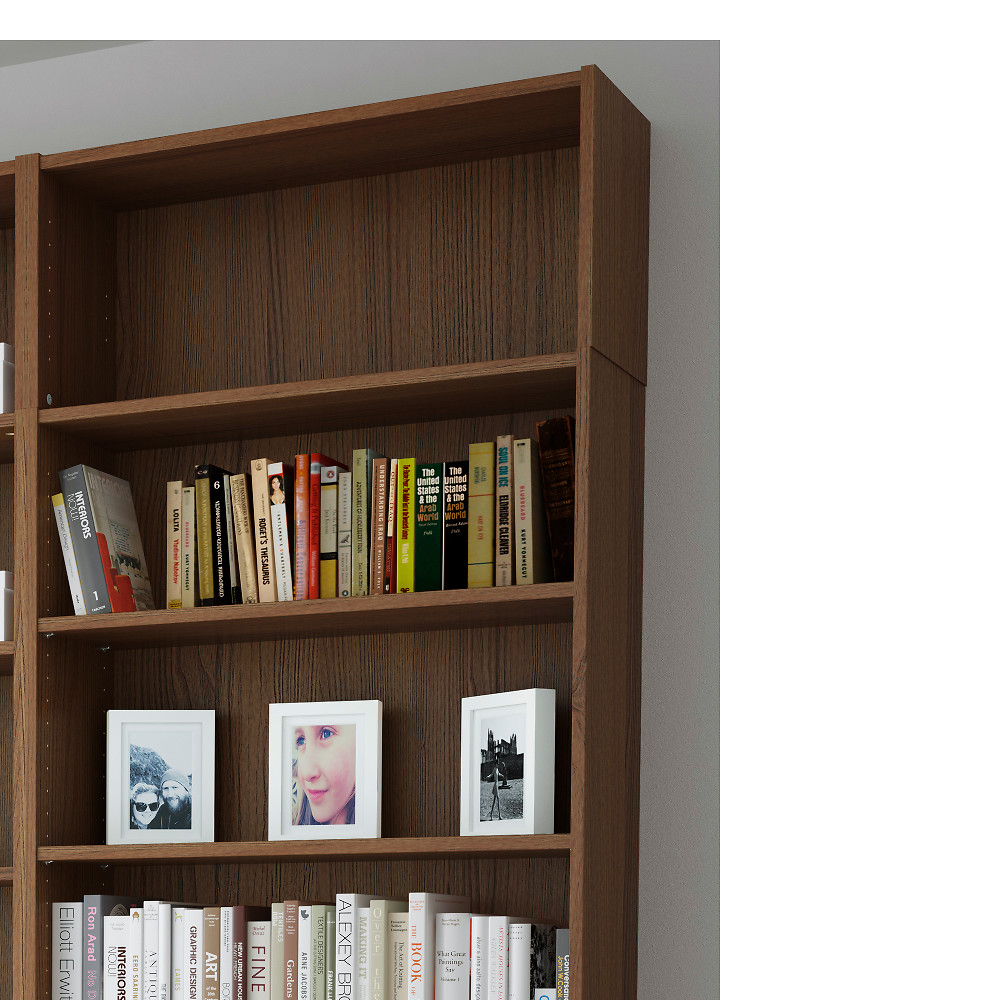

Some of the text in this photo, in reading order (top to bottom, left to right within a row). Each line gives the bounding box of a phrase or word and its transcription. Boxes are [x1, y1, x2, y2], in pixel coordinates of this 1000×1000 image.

[421, 468, 435, 477] The
[444, 474, 467, 485] United
[448, 466, 463, 476] The
[498, 447, 509, 489] SOUL ON ICE
[377, 464, 385, 523] UNDERSTANDING
[417, 476, 440, 487] United
[417, 486, 440, 496] States
[444, 483, 467, 494] States
[419, 494, 438, 505] & the
[419, 503, 437, 513] Arab
[446, 492, 465, 503] & the
[446, 501, 465, 512] Arab
[75, 490, 92, 540] INTERIORS
[417, 512, 439, 522] World
[444, 510, 467, 521] World
[499, 494, 509, 556] ELDRIDGE CLEAVER
[258, 517, 271, 586] ROGET'S THESAURUS
[59, 906, 75, 953] Elliott
[87, 906, 97, 931] Ron
[189, 925, 198, 966] GRAPHIC
[317, 915, 325, 976] TEXTILE DESIGNERS
[337, 899, 353, 968] ALEXEY
[87, 934, 97, 962] Arad
[300, 951, 308, 970] ARNE
[107, 945, 118, 978] NOW!
[204, 951, 218, 983] ART
[251, 945, 266, 994] FINE
[87, 969, 97, 988] No
[189, 966, 198, 1000] DESIGN
[286, 958, 295, 999] Gardens
